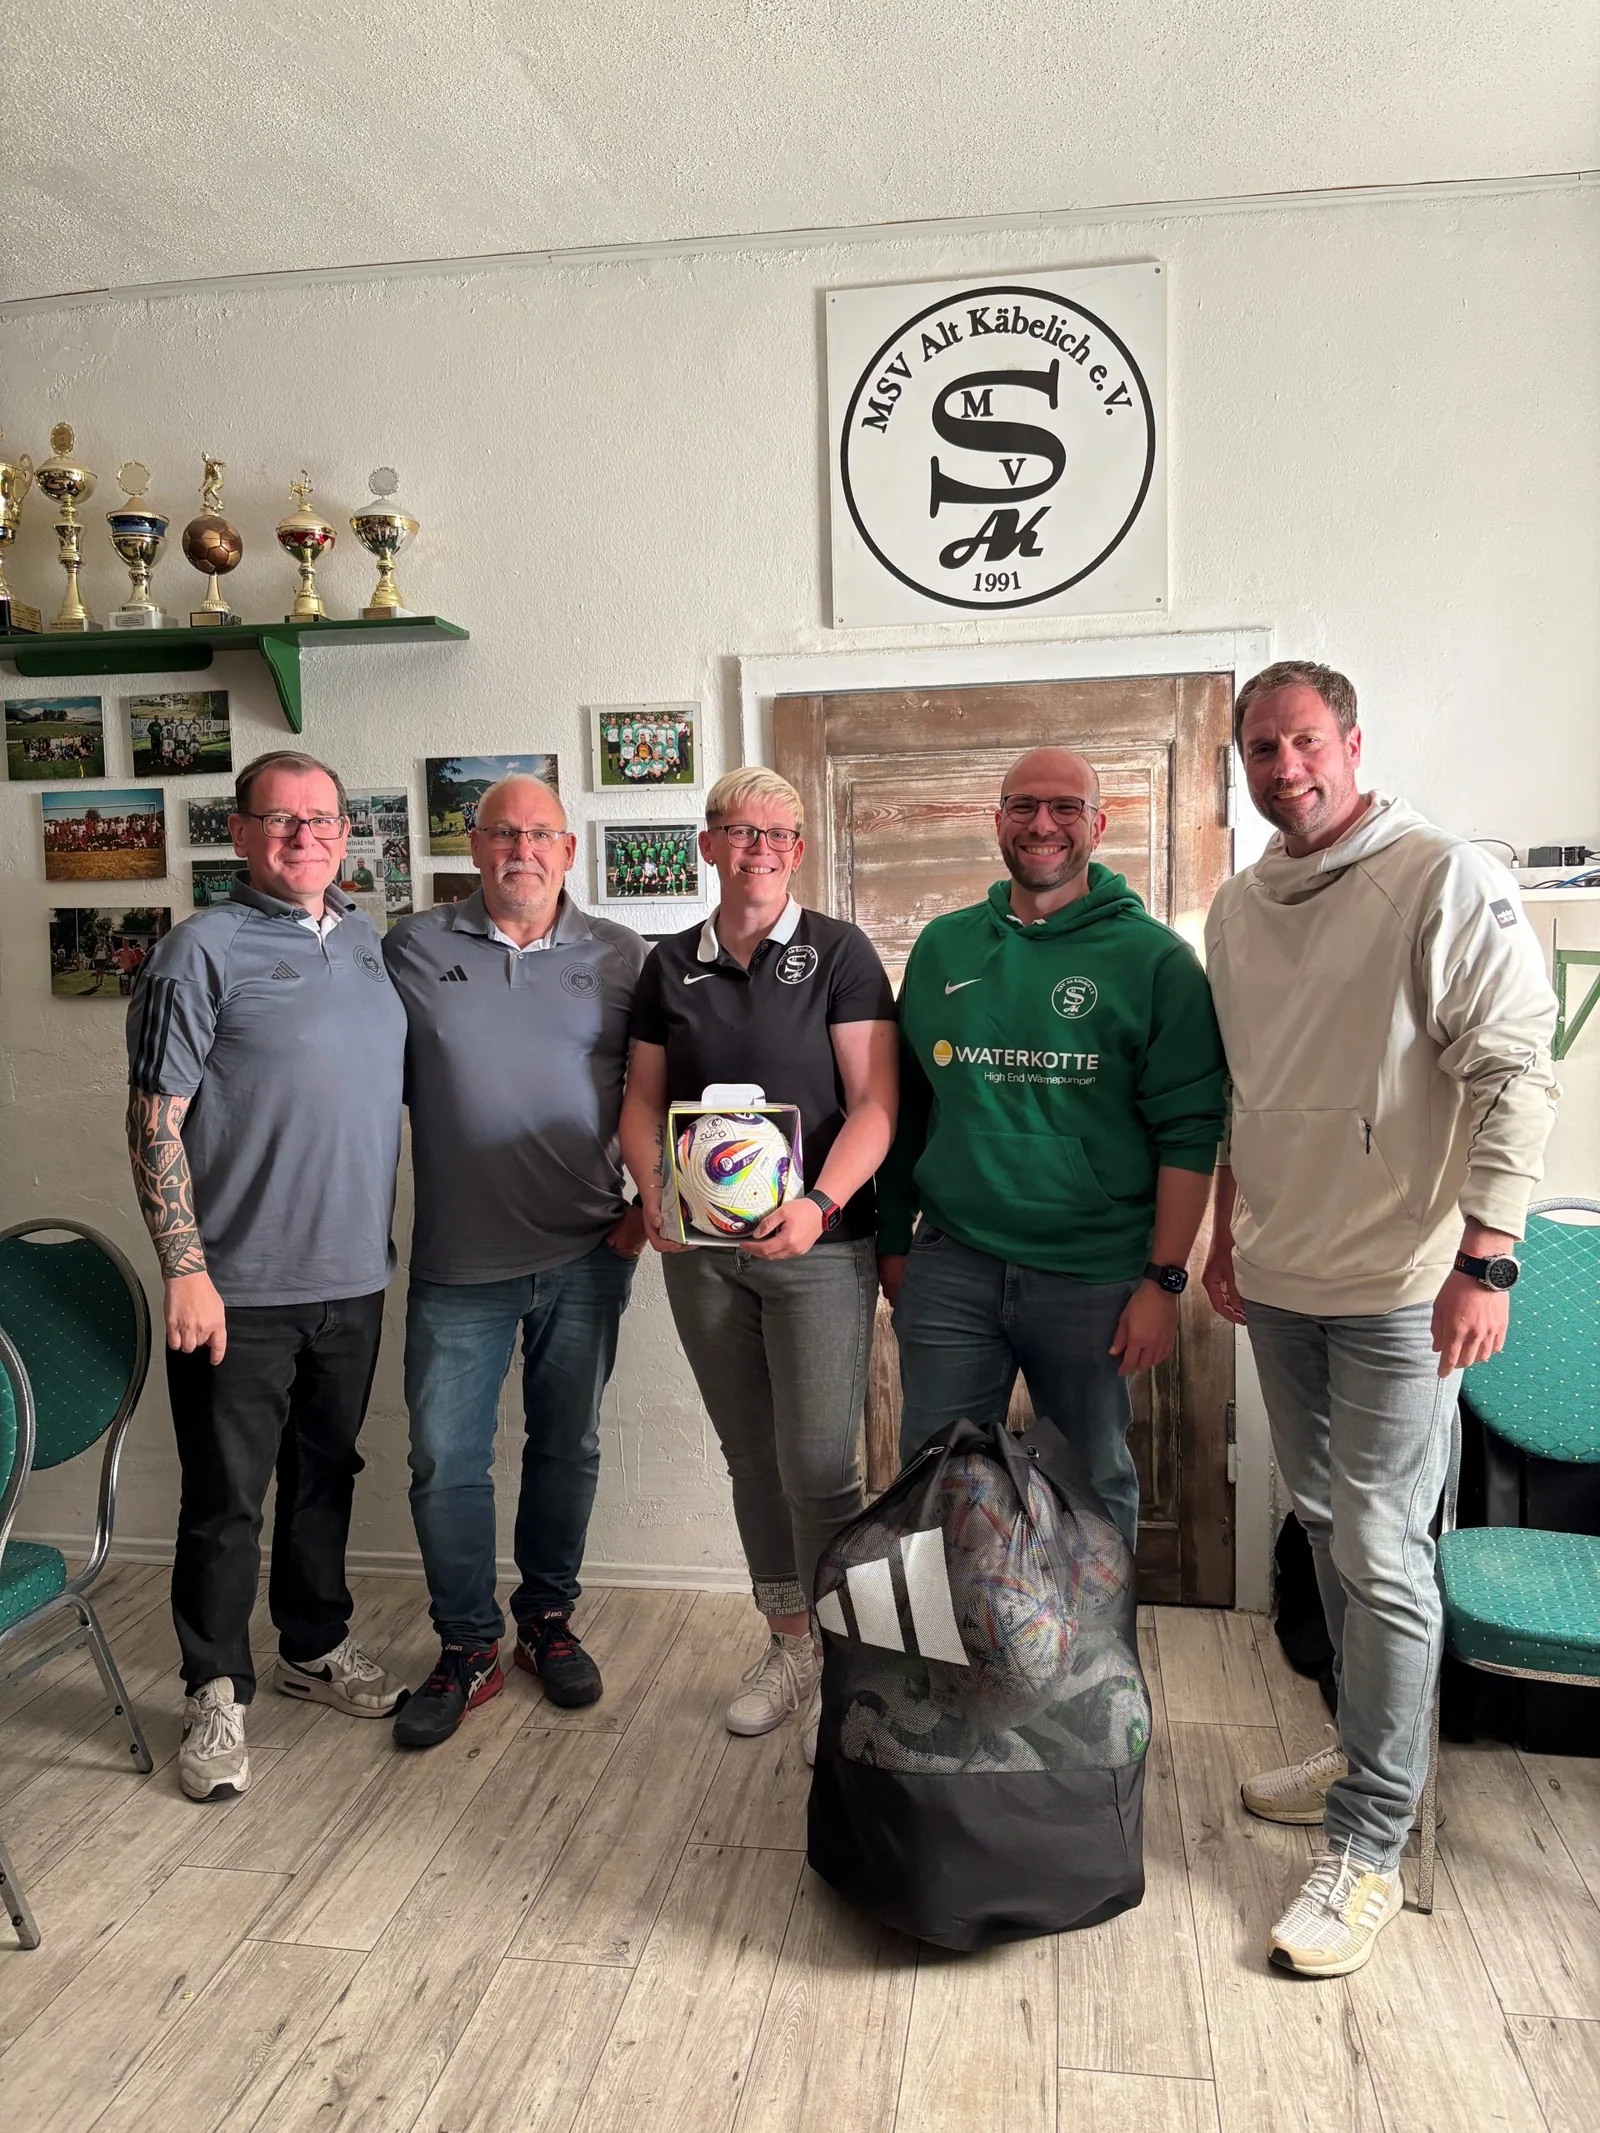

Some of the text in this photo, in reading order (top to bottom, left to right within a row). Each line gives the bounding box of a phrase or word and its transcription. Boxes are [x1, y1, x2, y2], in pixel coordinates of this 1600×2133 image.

[861, 352, 912, 433] MSV
[921, 321, 963, 362] Alt
[966, 305, 1091, 366] Käbelich
[961, 388, 993, 418] M
[999, 457, 1026, 485] V
[973, 571, 1022, 592] 1991
[955, 1046, 1099, 1070] WATERKOTTE
[984, 1071, 1005, 1084] High
[1008, 1072, 1026, 1083] End
